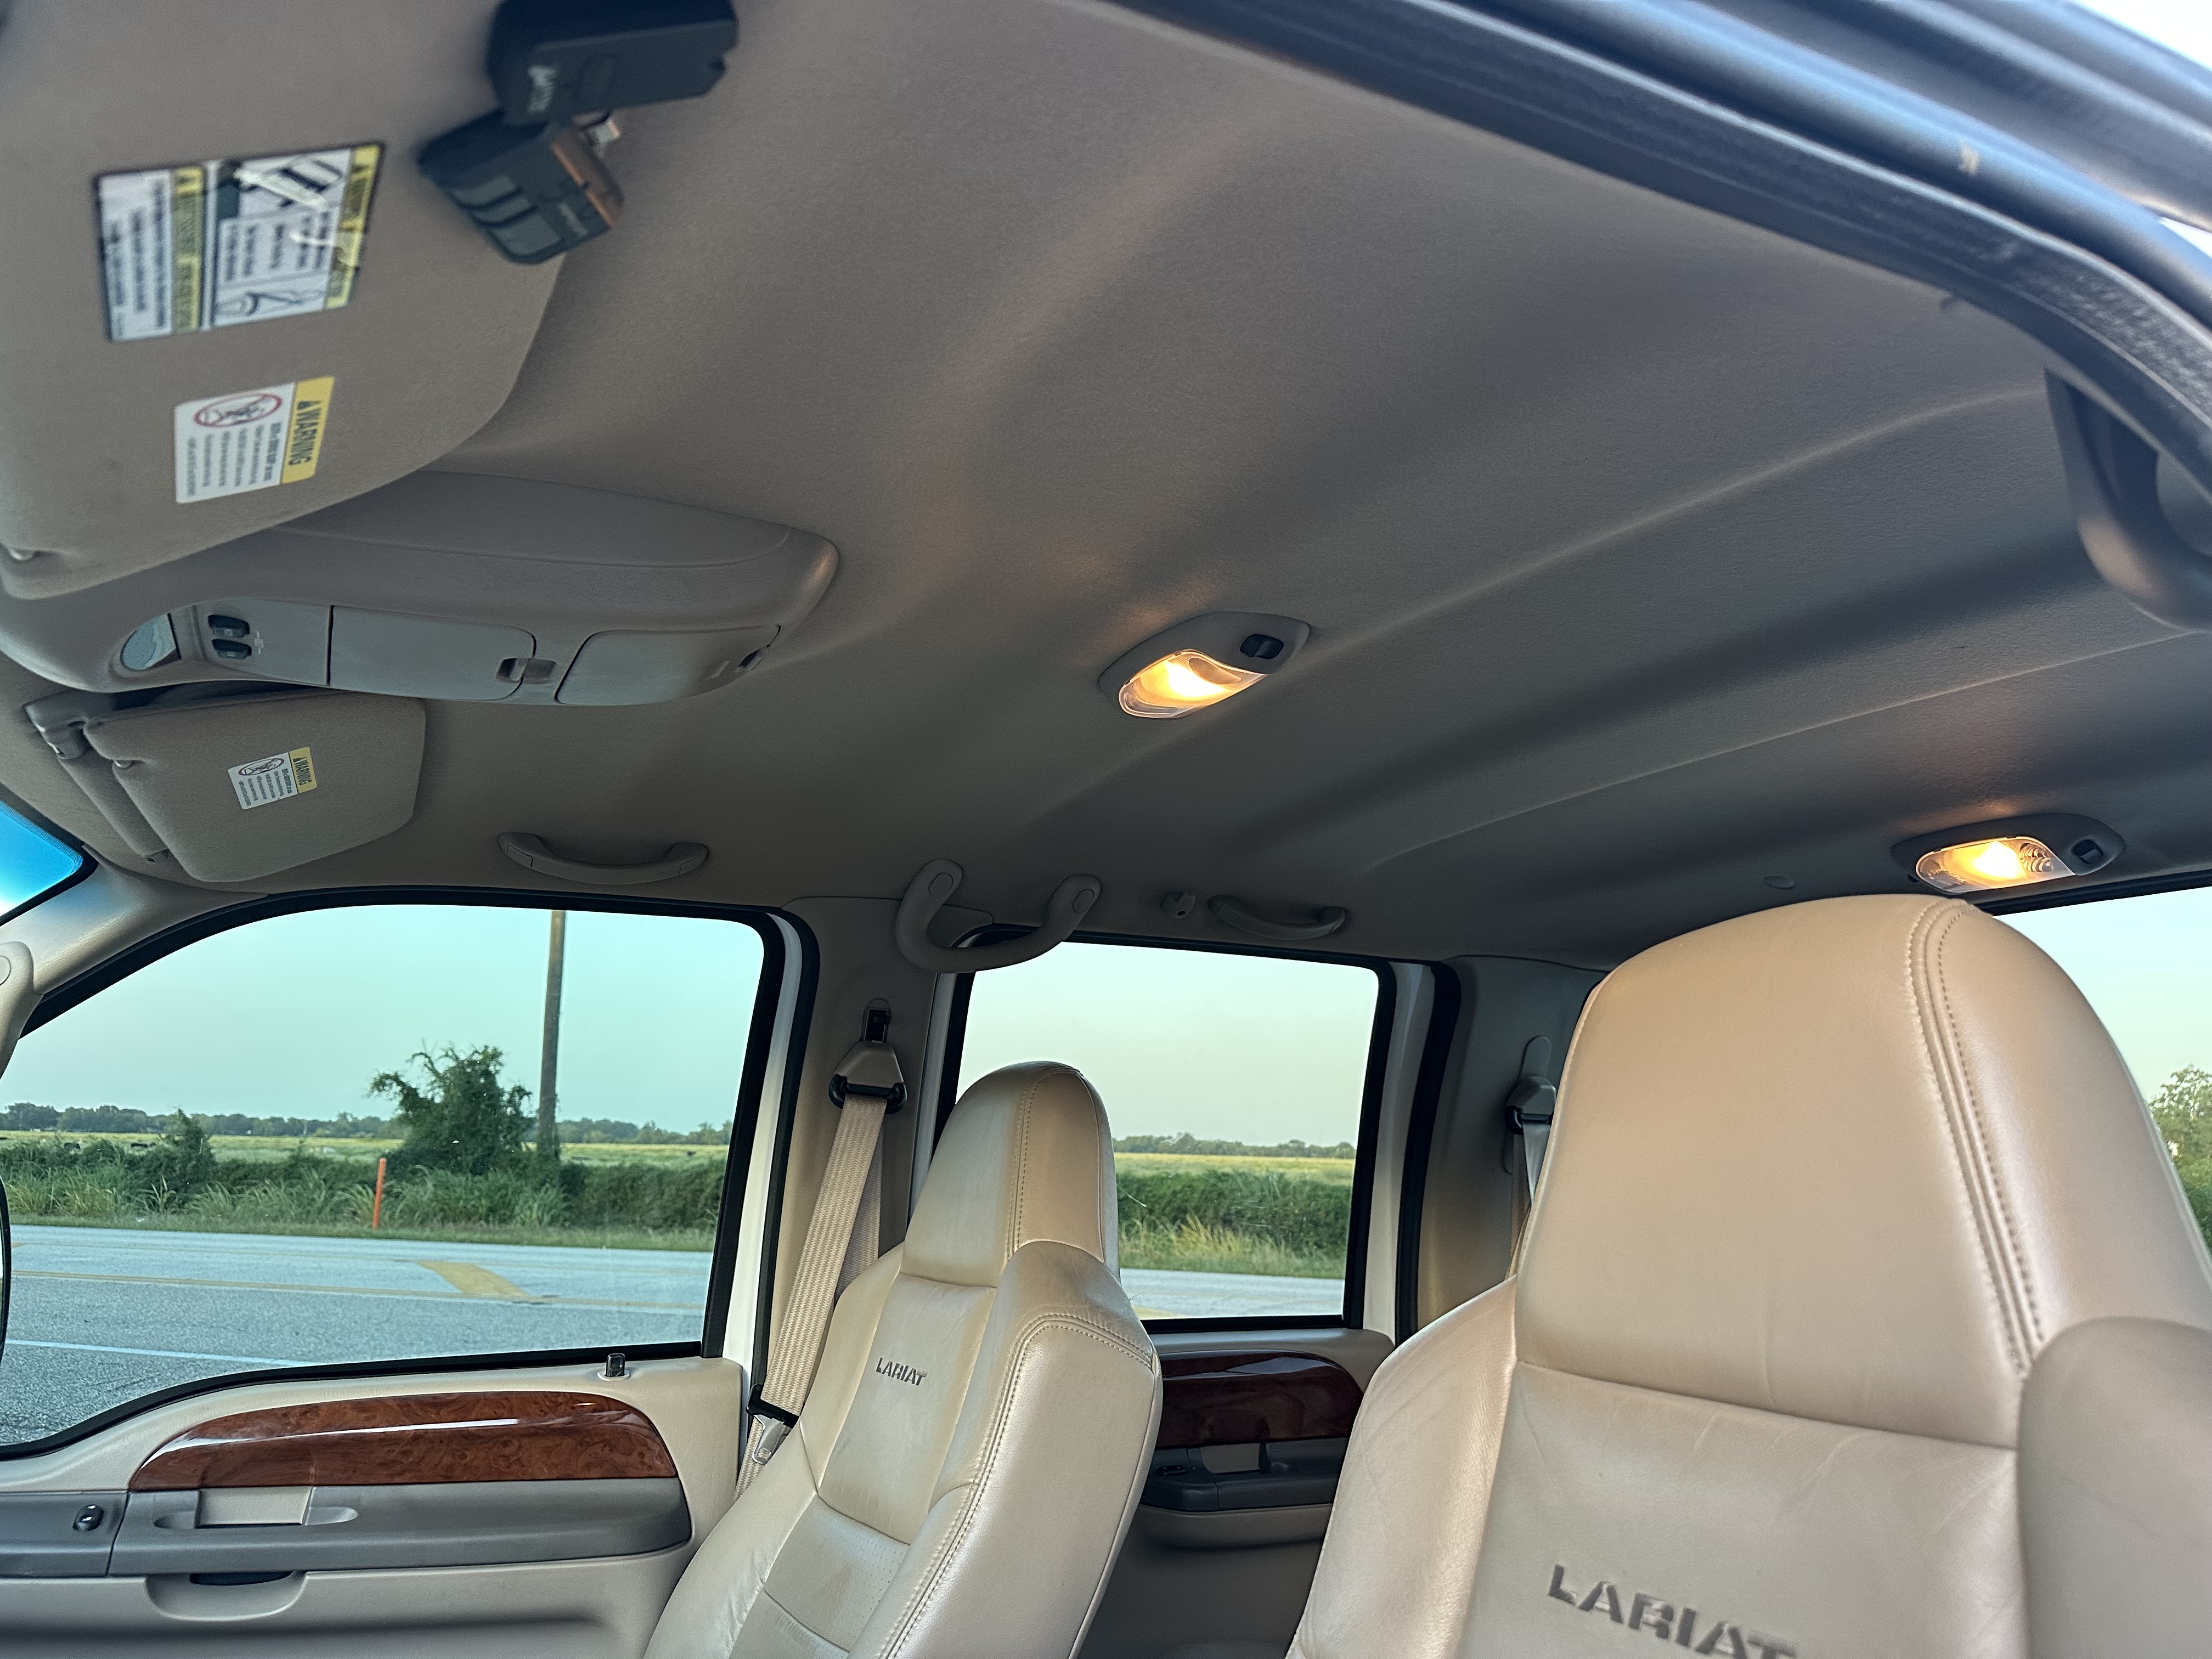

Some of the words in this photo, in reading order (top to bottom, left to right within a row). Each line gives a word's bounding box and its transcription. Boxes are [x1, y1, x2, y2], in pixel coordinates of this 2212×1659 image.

[288, 408, 321, 466] WARNING
[295, 759, 312, 786] WARNING
[876, 1357, 928, 1386] LARIAT
